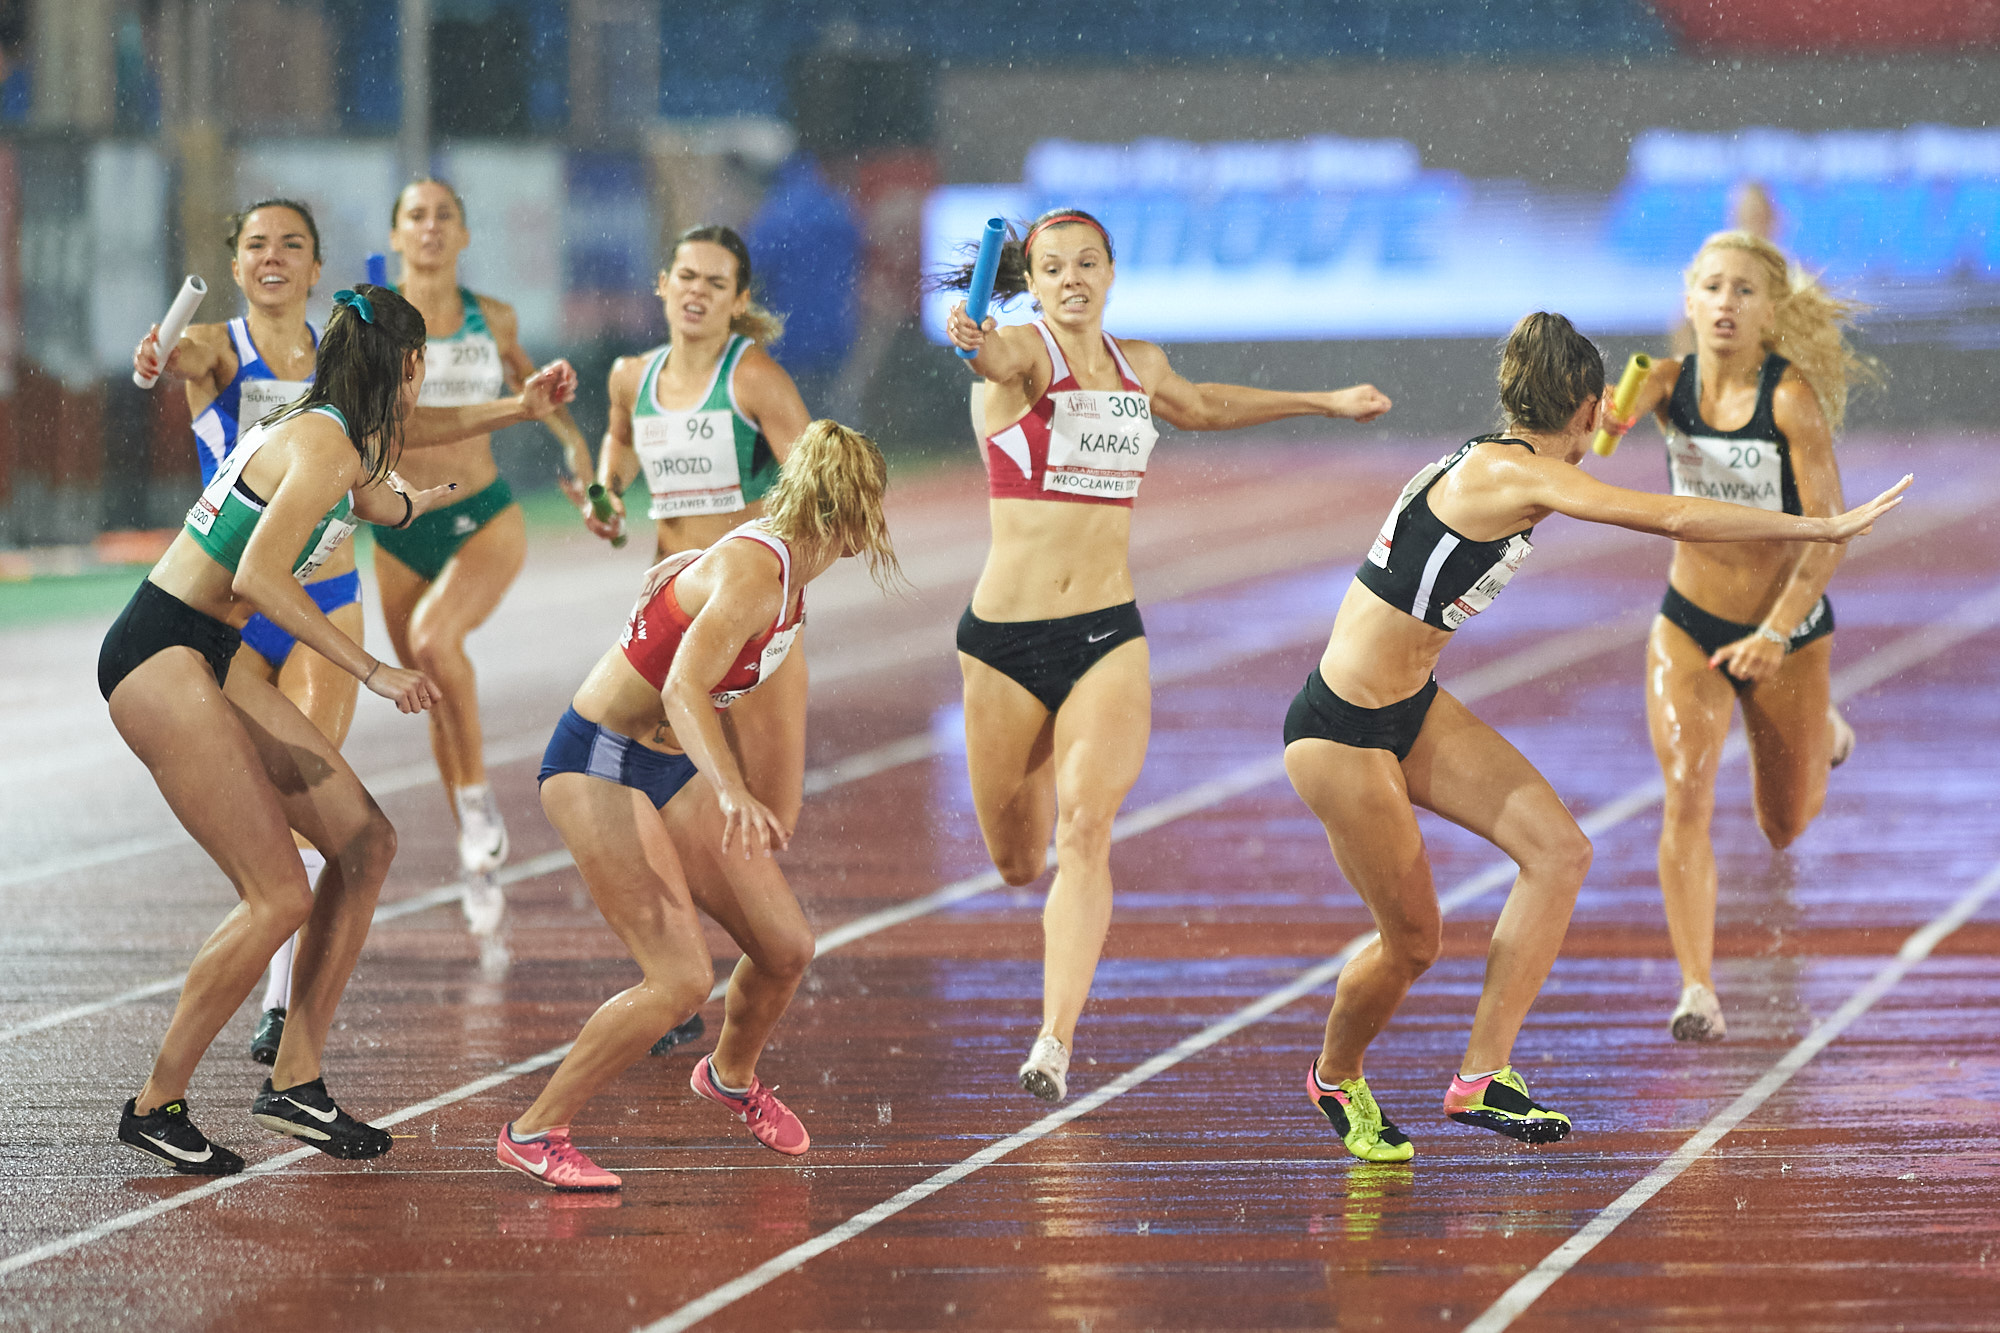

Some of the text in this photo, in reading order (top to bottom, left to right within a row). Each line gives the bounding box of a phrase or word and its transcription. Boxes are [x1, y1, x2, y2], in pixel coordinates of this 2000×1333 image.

[247, 394, 286, 403] SUUNTO
[1108, 396, 1149, 420] 308
[686, 417, 714, 441] 96
[1079, 432, 1140, 456] KARAŚ
[652, 457, 712, 477] DROZD
[1728, 446, 1761, 469] 20
[711, 494, 736, 508] 2020
